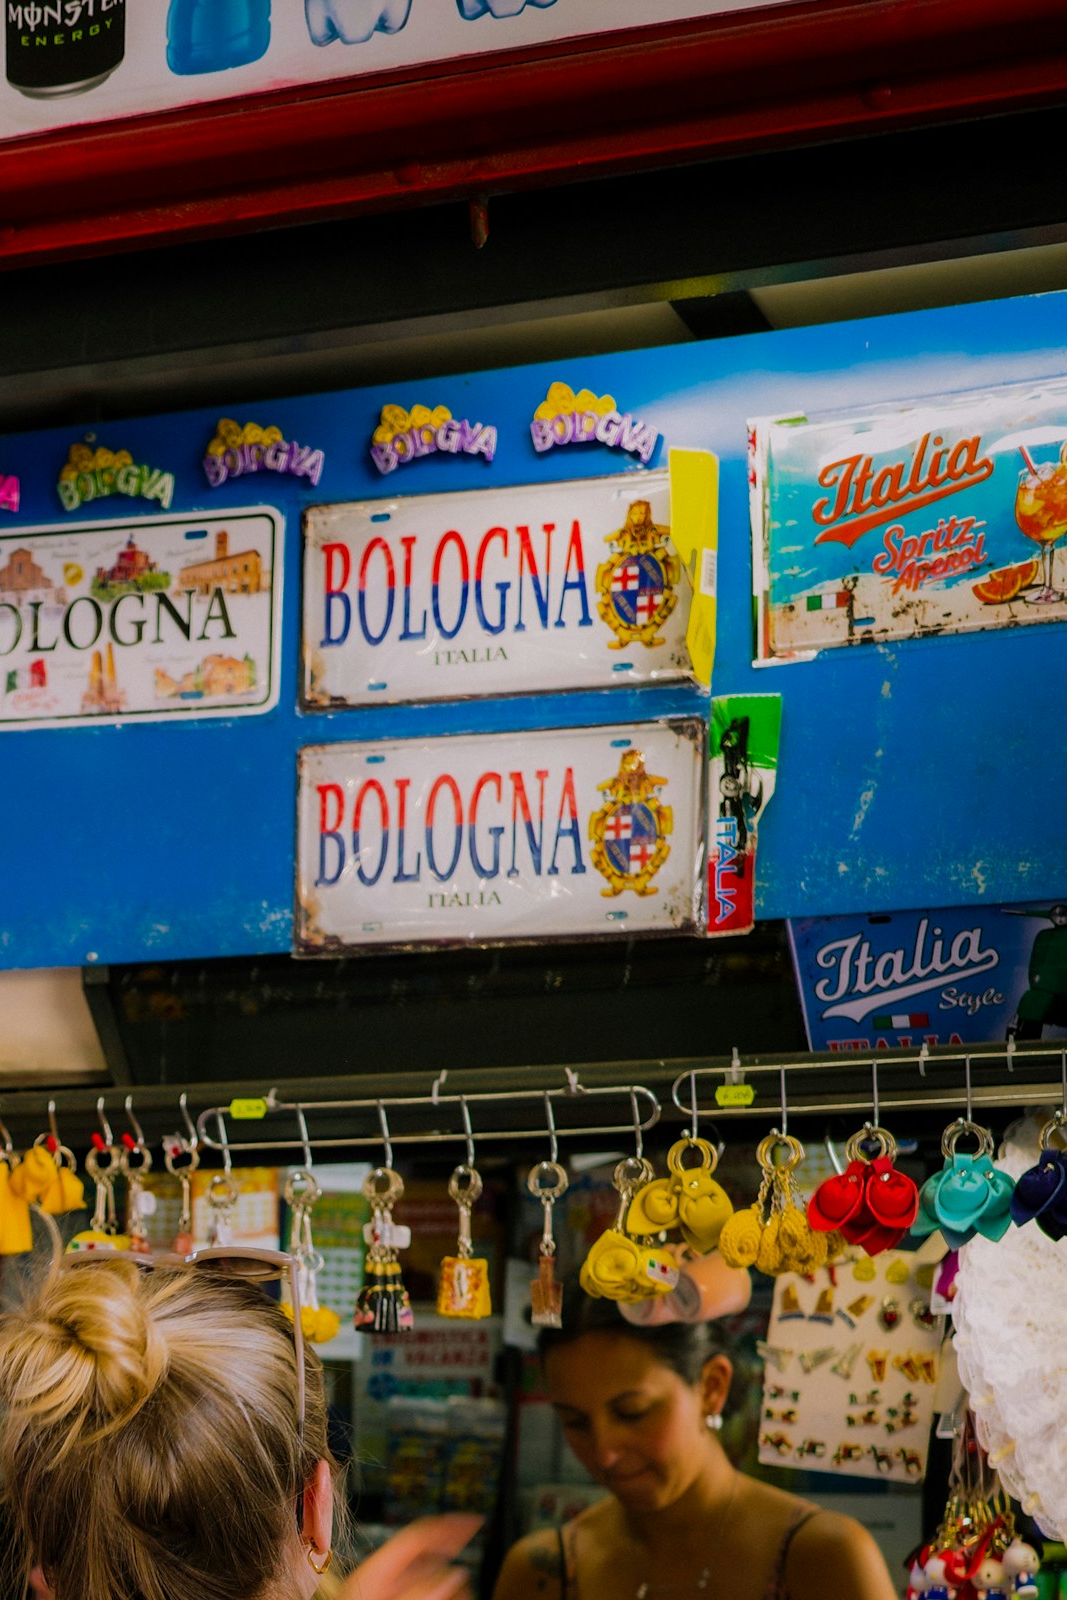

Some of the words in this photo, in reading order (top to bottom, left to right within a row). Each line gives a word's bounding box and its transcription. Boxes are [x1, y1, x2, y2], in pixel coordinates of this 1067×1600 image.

[21, 18, 113, 46] ENERGY
[812, 432, 994, 527] Italia
[320, 519, 593, 649] BOLOGNA
[434, 645, 510, 667] ITALIA
[315, 766, 587, 889] BOLOGNA
[427, 890, 503, 909] ITALIA
[715, 816, 739, 925] ITALIA
[814, 918, 1000, 1002] Italia
[938, 987, 1007, 1016] Style
